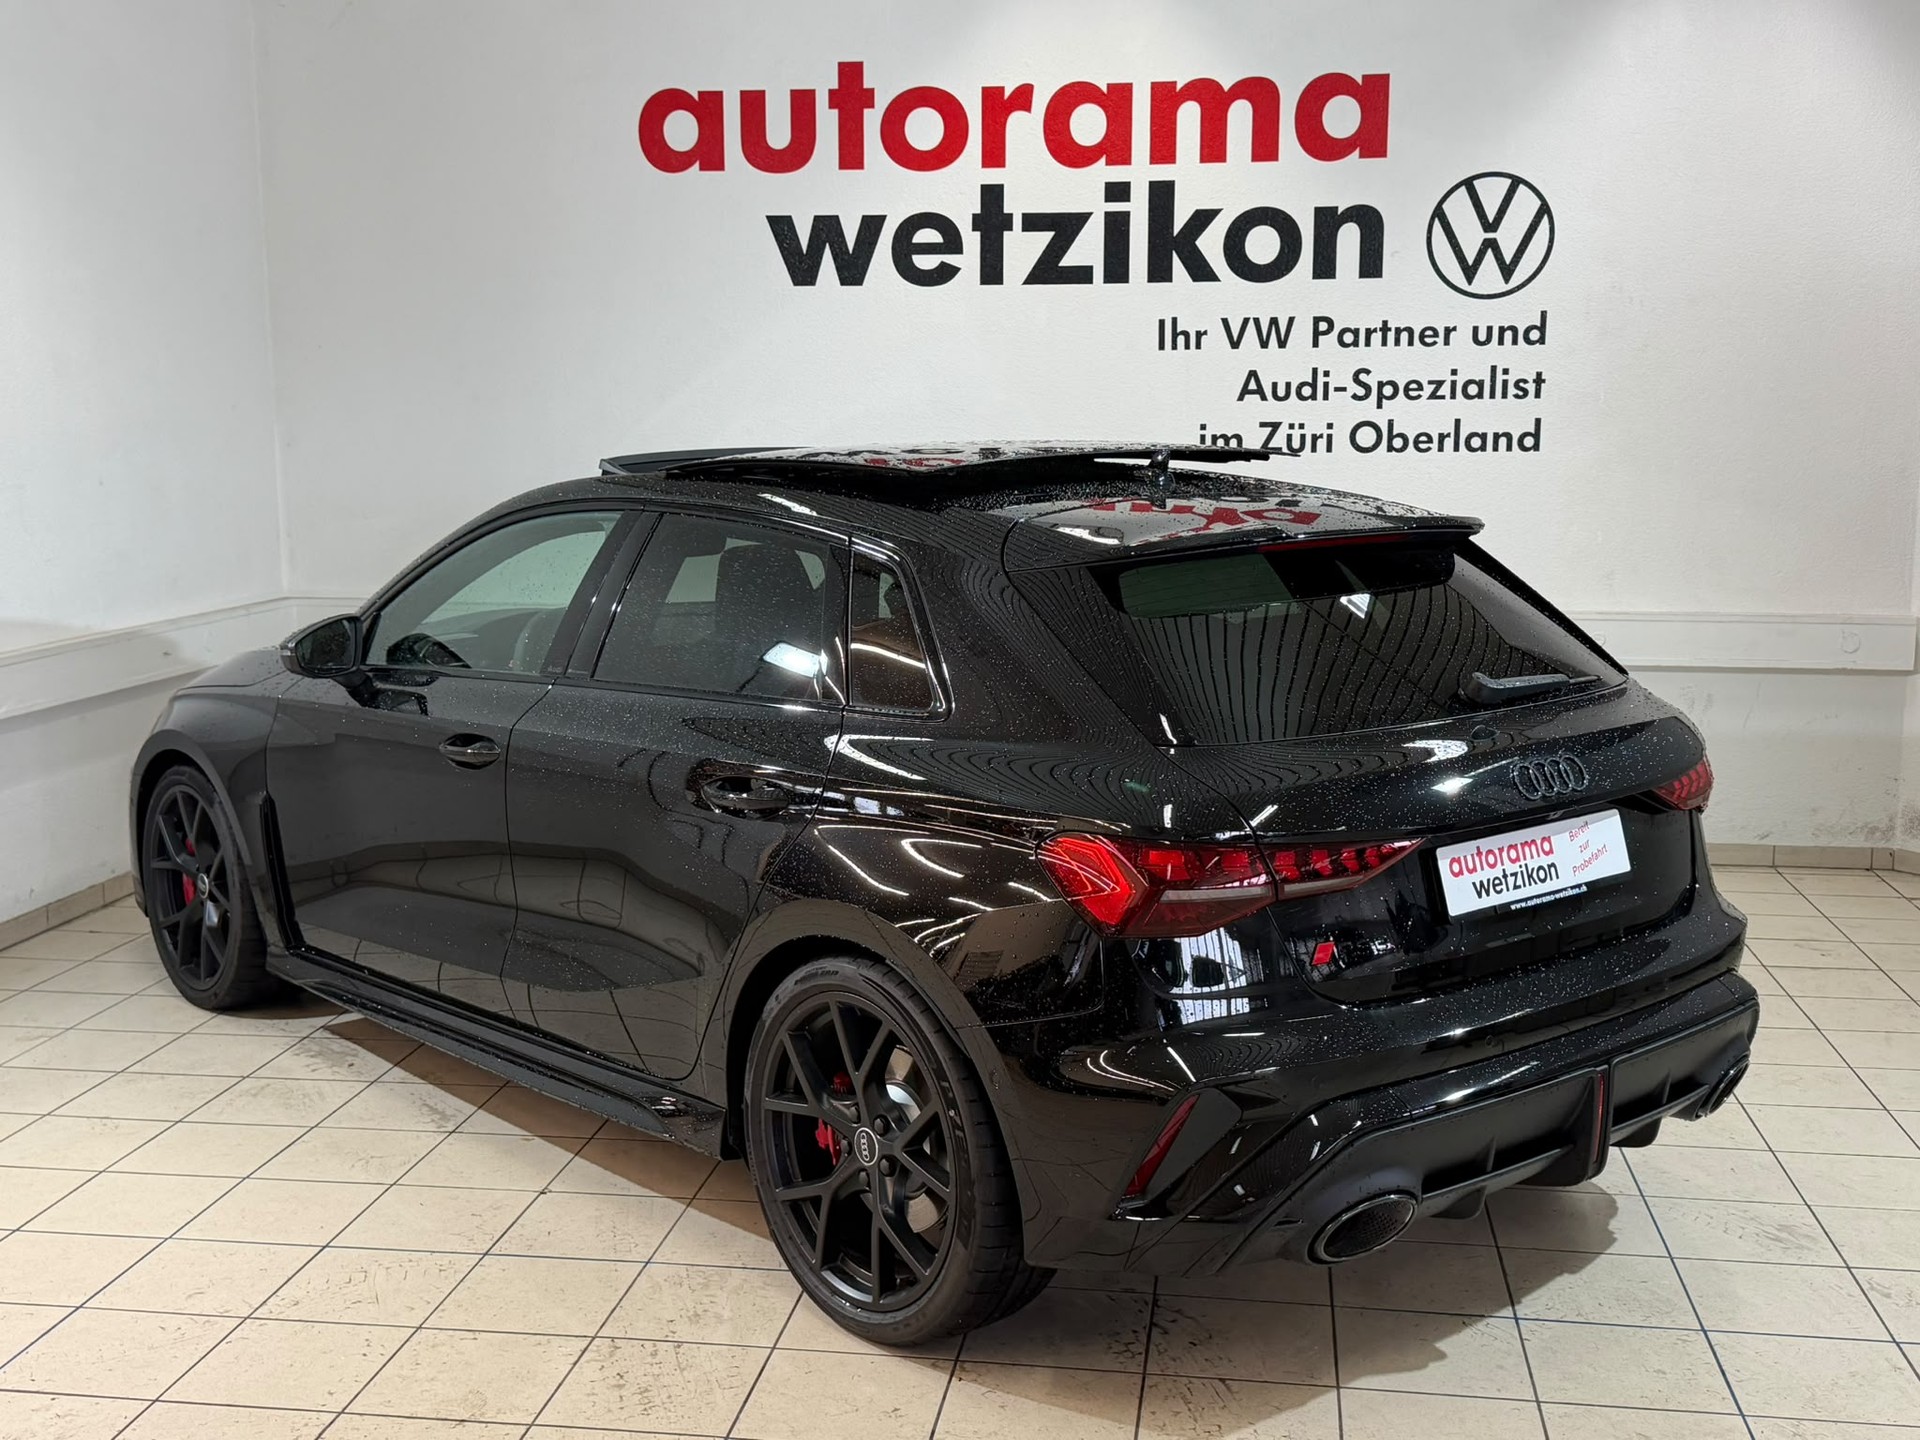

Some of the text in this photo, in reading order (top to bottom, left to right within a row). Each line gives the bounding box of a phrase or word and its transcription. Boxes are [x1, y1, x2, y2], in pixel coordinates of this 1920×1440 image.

[639, 62, 1391, 173] autorama
[766, 180, 1385, 287] wetzikon
[1158, 311, 1548, 351] Ihr VW Partner und
[1237, 364, 1546, 410] Audi-Spezialist
[1199, 418, 1542, 454] im Züri Oberland
[1569, 821, 1590, 842] Bereit
[1579, 839, 1590, 854] zur
[1449, 835, 1555, 878] autorama
[1572, 844, 1608, 877] Probefahrt
[1472, 861, 1560, 899] wetzikon
